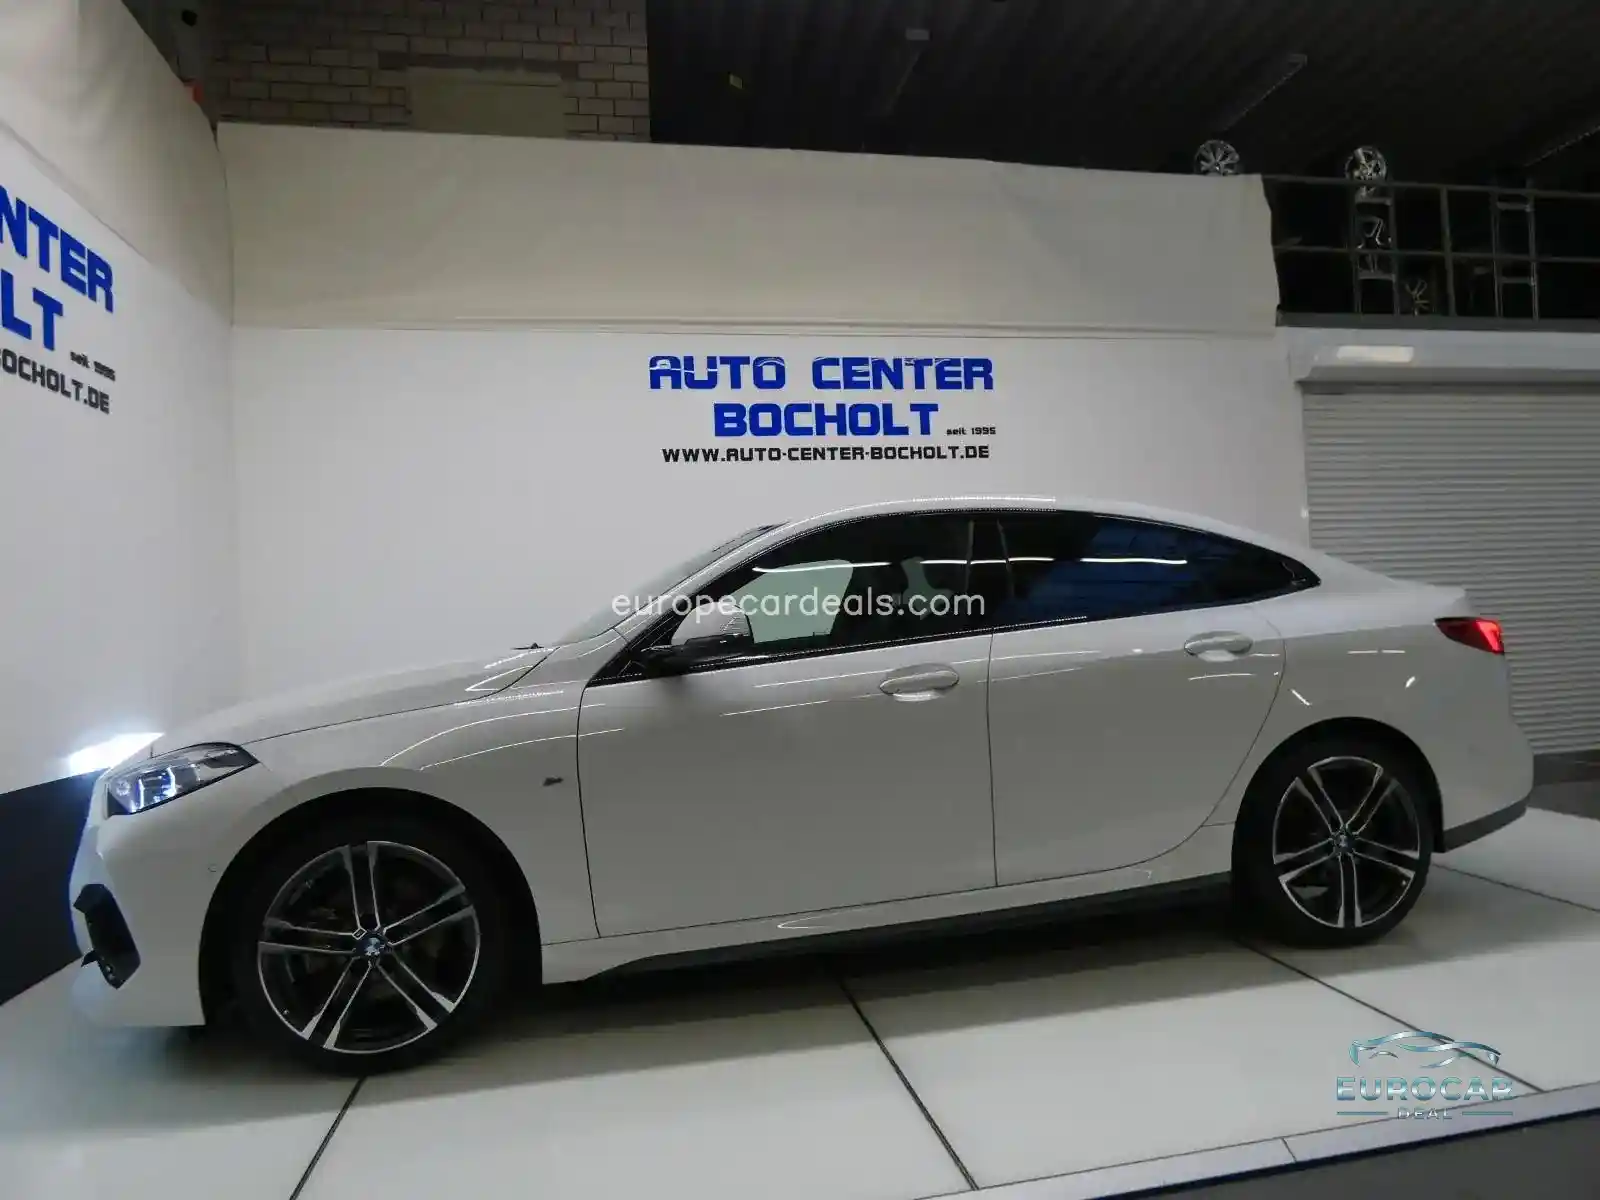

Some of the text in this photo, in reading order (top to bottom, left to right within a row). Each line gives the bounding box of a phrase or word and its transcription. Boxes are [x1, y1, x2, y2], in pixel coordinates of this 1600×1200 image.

[0, 348, 110, 415] OCHOLT.DE
[649, 356, 994, 390] AUTO CENTER
[714, 403, 996, 437] BOCHOLT seit 1995
[662, 446, 989, 463] WWW.AUTO-CENTER-BOCHOLT.DE
